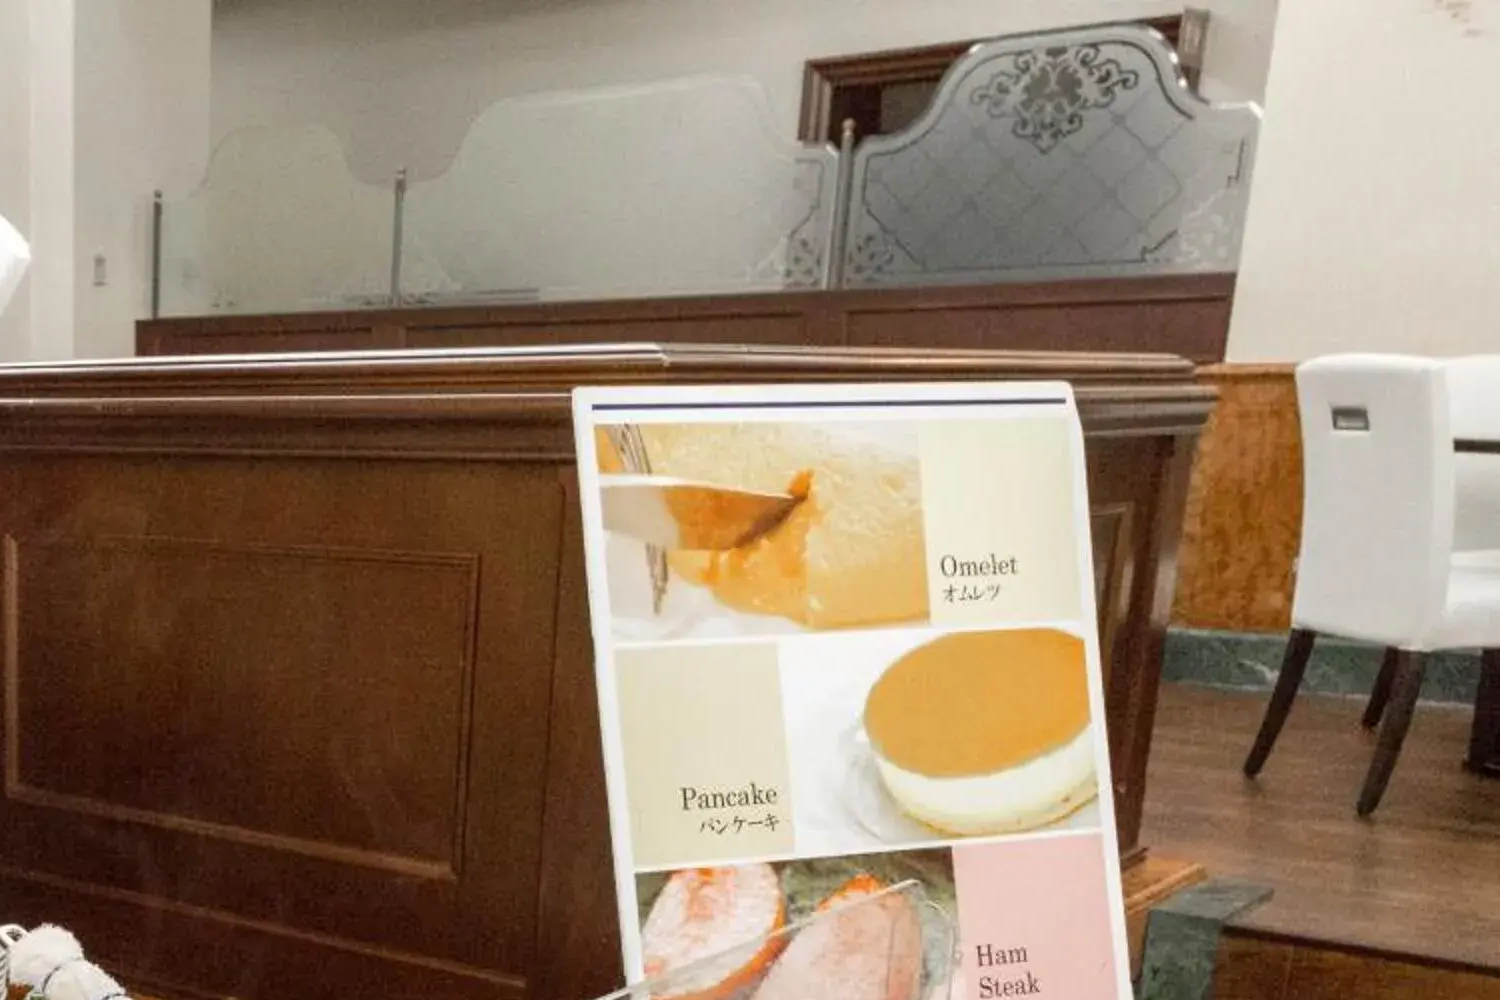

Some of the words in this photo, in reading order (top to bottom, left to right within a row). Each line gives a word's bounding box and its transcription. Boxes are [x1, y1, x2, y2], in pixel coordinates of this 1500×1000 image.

[939, 552, 1018, 577] Omelet
[942, 583, 1000, 603] オムレツ
[680, 781, 777, 810] Pancake
[700, 813, 780, 835] パンケーキ
[977, 943, 1028, 967] Ham
[979, 969, 1040, 999] Steak
